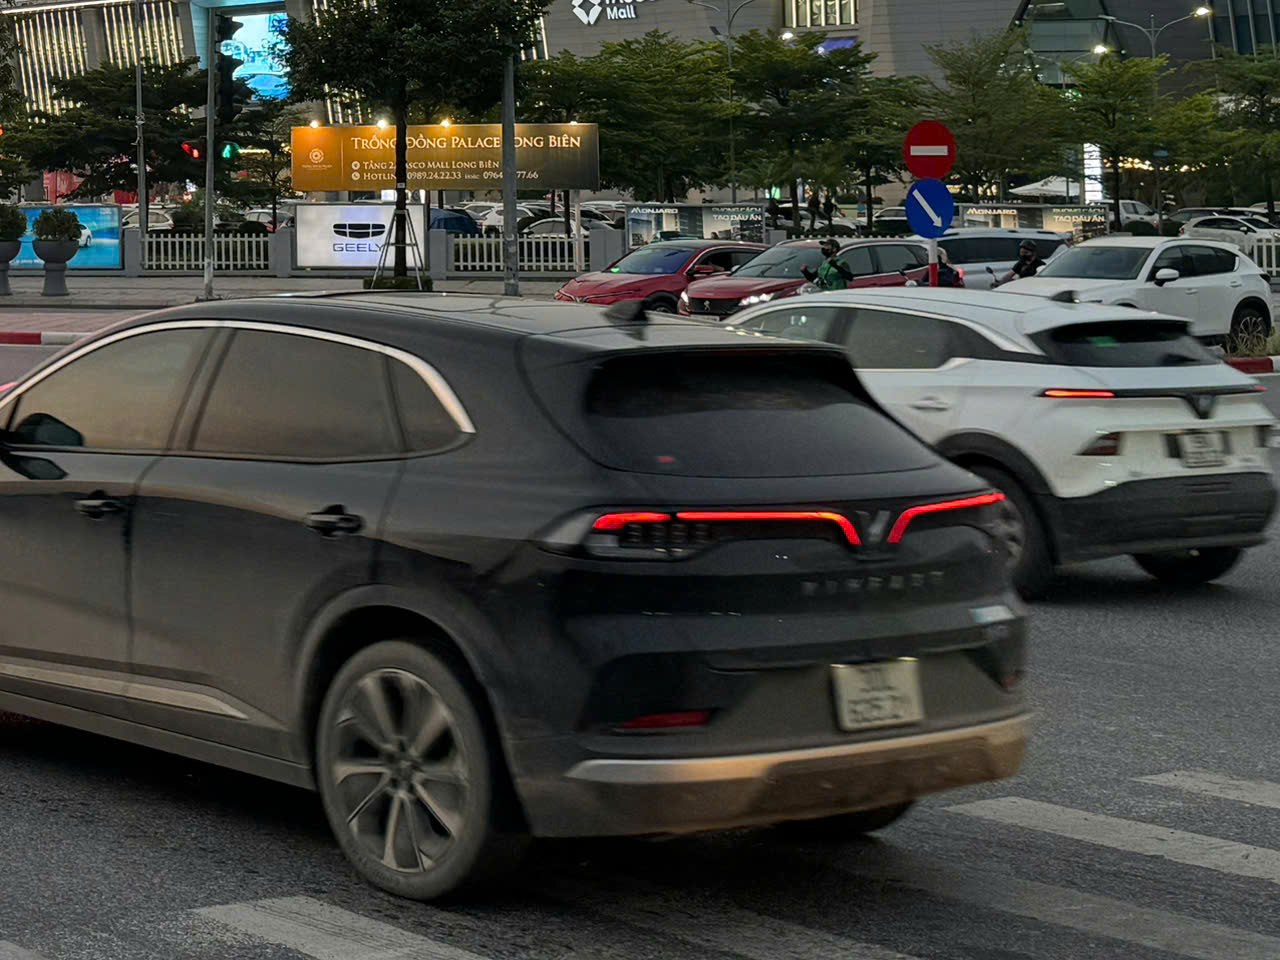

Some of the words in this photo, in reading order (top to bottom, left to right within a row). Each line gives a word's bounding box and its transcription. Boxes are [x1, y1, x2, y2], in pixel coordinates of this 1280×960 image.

[606, 4, 636, 20] Mall
[451, 136, 501, 148] PALACE
[514, 136, 544, 148] ONG
[549, 134, 581, 148] BIÊN
[452, 161, 477, 169] LONG
[363, 172, 397, 180] HOTLIN
[332, 243, 384, 252] GEELY
